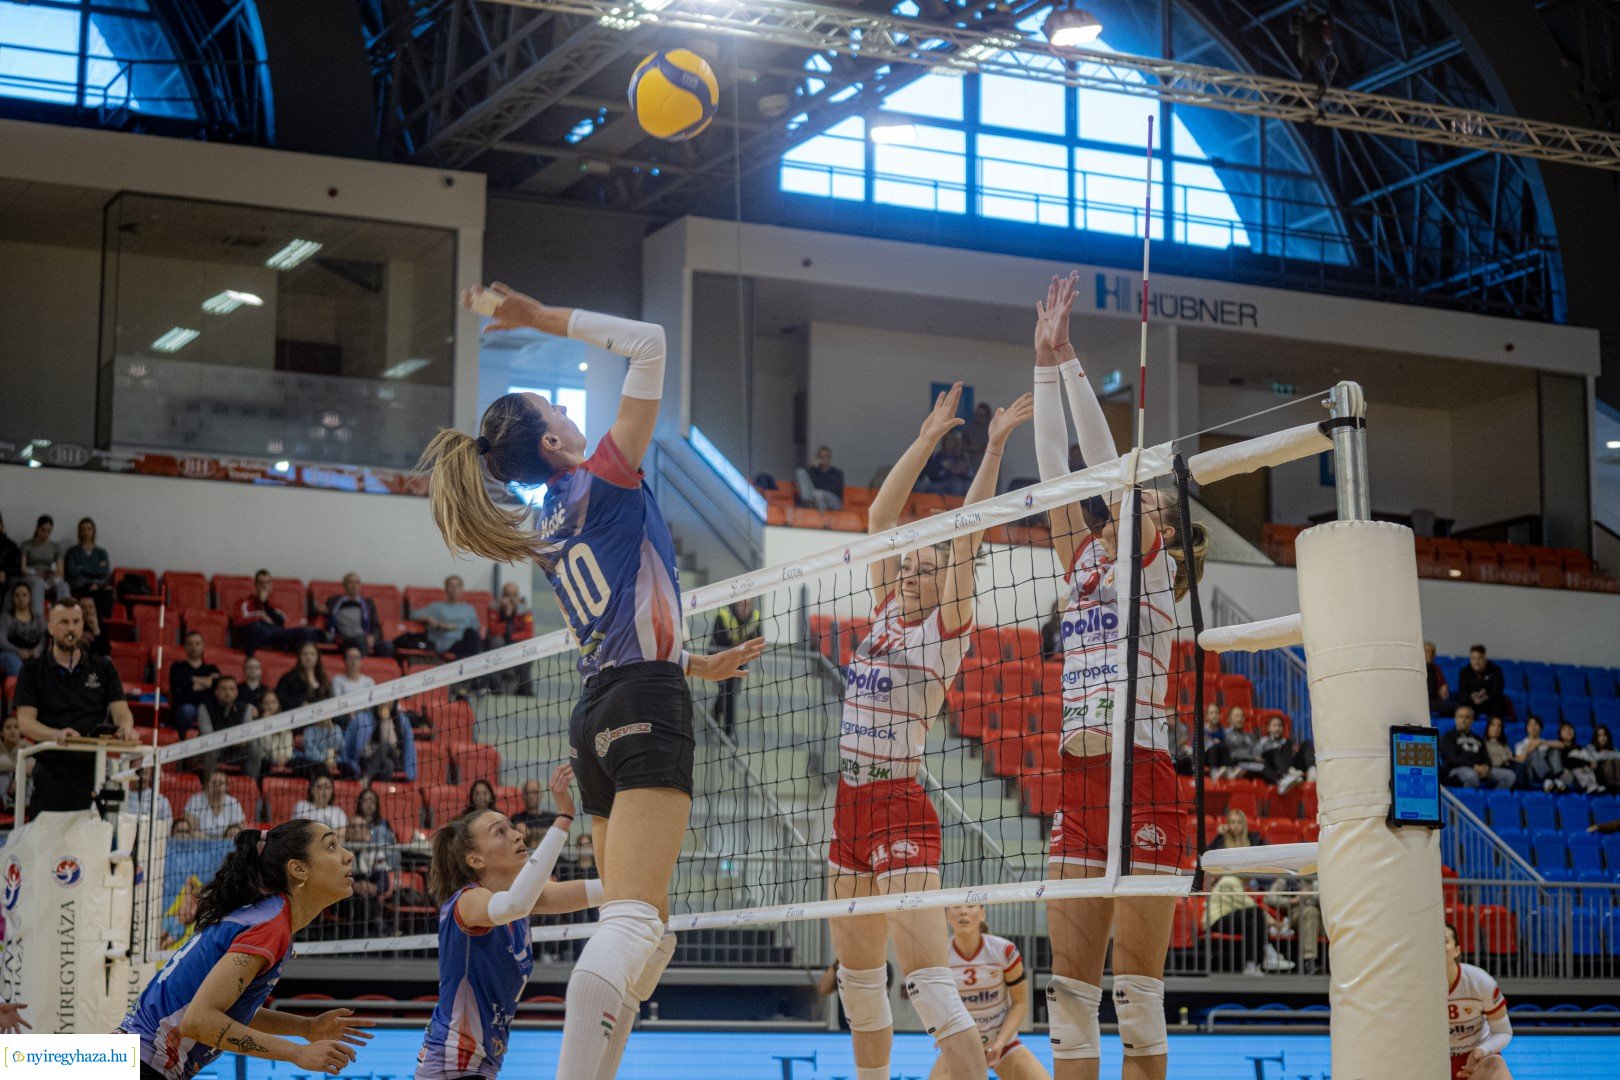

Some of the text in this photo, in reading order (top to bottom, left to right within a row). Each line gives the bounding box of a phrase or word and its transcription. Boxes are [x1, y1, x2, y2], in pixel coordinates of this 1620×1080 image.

[1137, 290, 1258, 328] HÜBNER
[555, 542, 611, 626] 10
[1062, 606, 1118, 642] pollo
[841, 720, 897, 741] ngropack
[964, 968, 977, 986] 3
